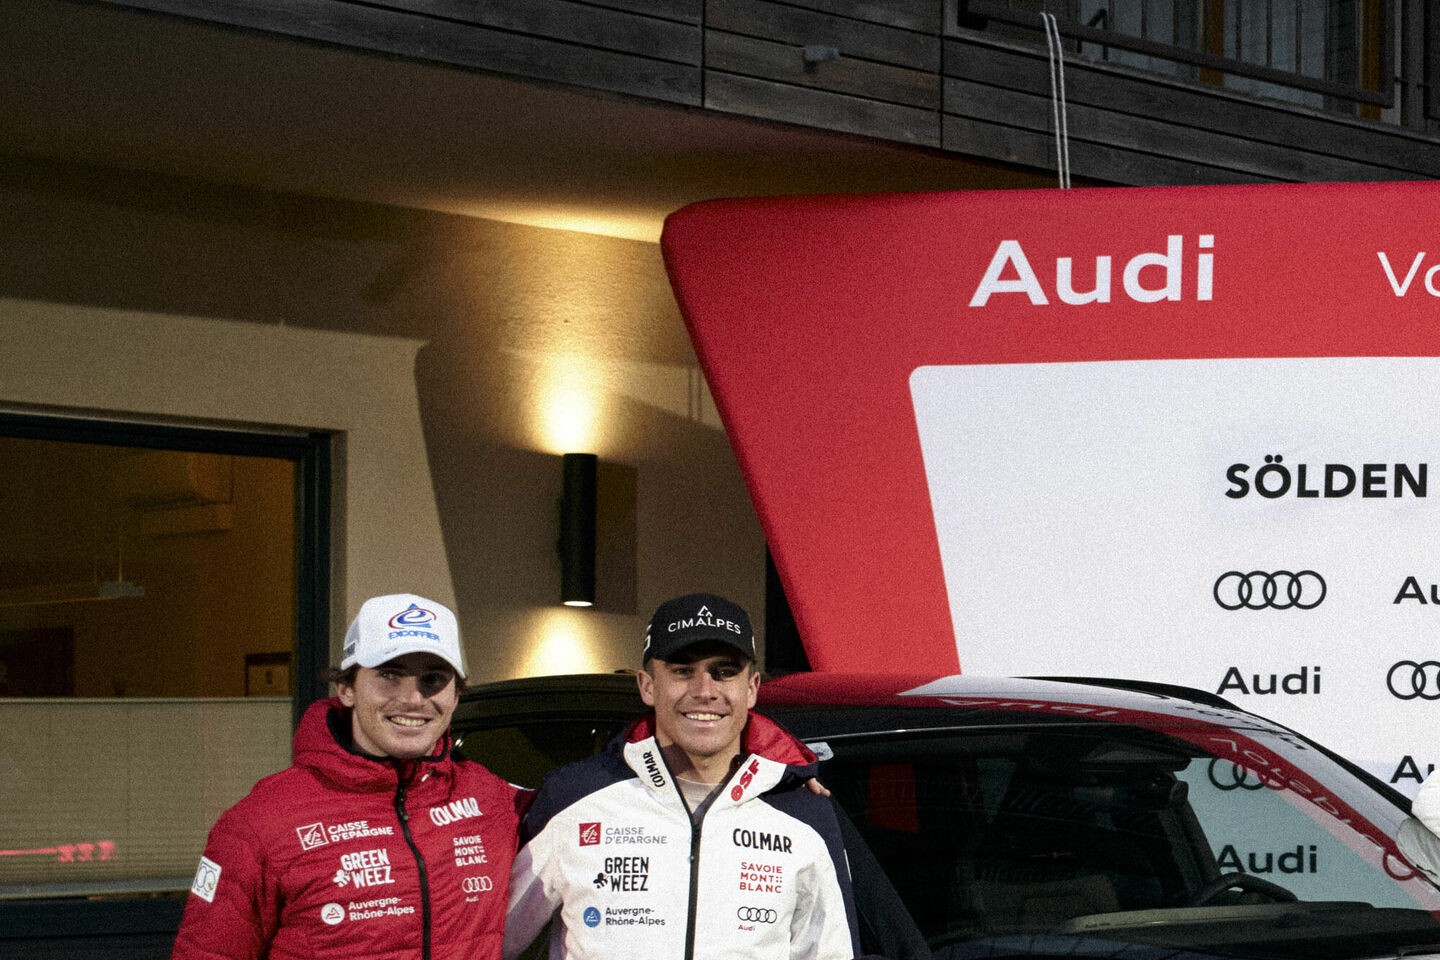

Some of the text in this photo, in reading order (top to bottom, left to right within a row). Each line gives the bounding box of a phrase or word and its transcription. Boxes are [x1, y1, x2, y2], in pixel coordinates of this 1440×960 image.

[968, 234, 1215, 307] Audi
[1225, 454, 1428, 499] SÖLDEN
[667, 617, 741, 634] CIMALPES
[1216, 666, 1321, 695] Audi
[642, 751, 666, 788] COLMAR
[429, 797, 482, 827] COLMAR
[327, 820, 369, 835] CAISSE
[331, 826, 394, 843] D'EPARGNE
[605, 826, 645, 836] CAISSE
[453, 835, 482, 846] SAVOIE
[605, 835, 667, 845] D'EPARGNE
[733, 828, 793, 854] COLMAR
[341, 848, 390, 871] GREEN
[455, 854, 488, 867] BLANC
[605, 856, 649, 875] GREEN
[741, 861, 783, 873] SAVOIE
[1217, 845, 1318, 874] Audi
[352, 865, 395, 888] WEEZ
[610, 874, 649, 892] WEEZ
[739, 882, 782, 894] BLANC
[349, 897, 402, 911] Auvergne-
[605, 906, 655, 918] Auvergne-
[349, 905, 415, 921] Rhône-Alpes
[605, 915, 665, 926] Rhône-Alpes
